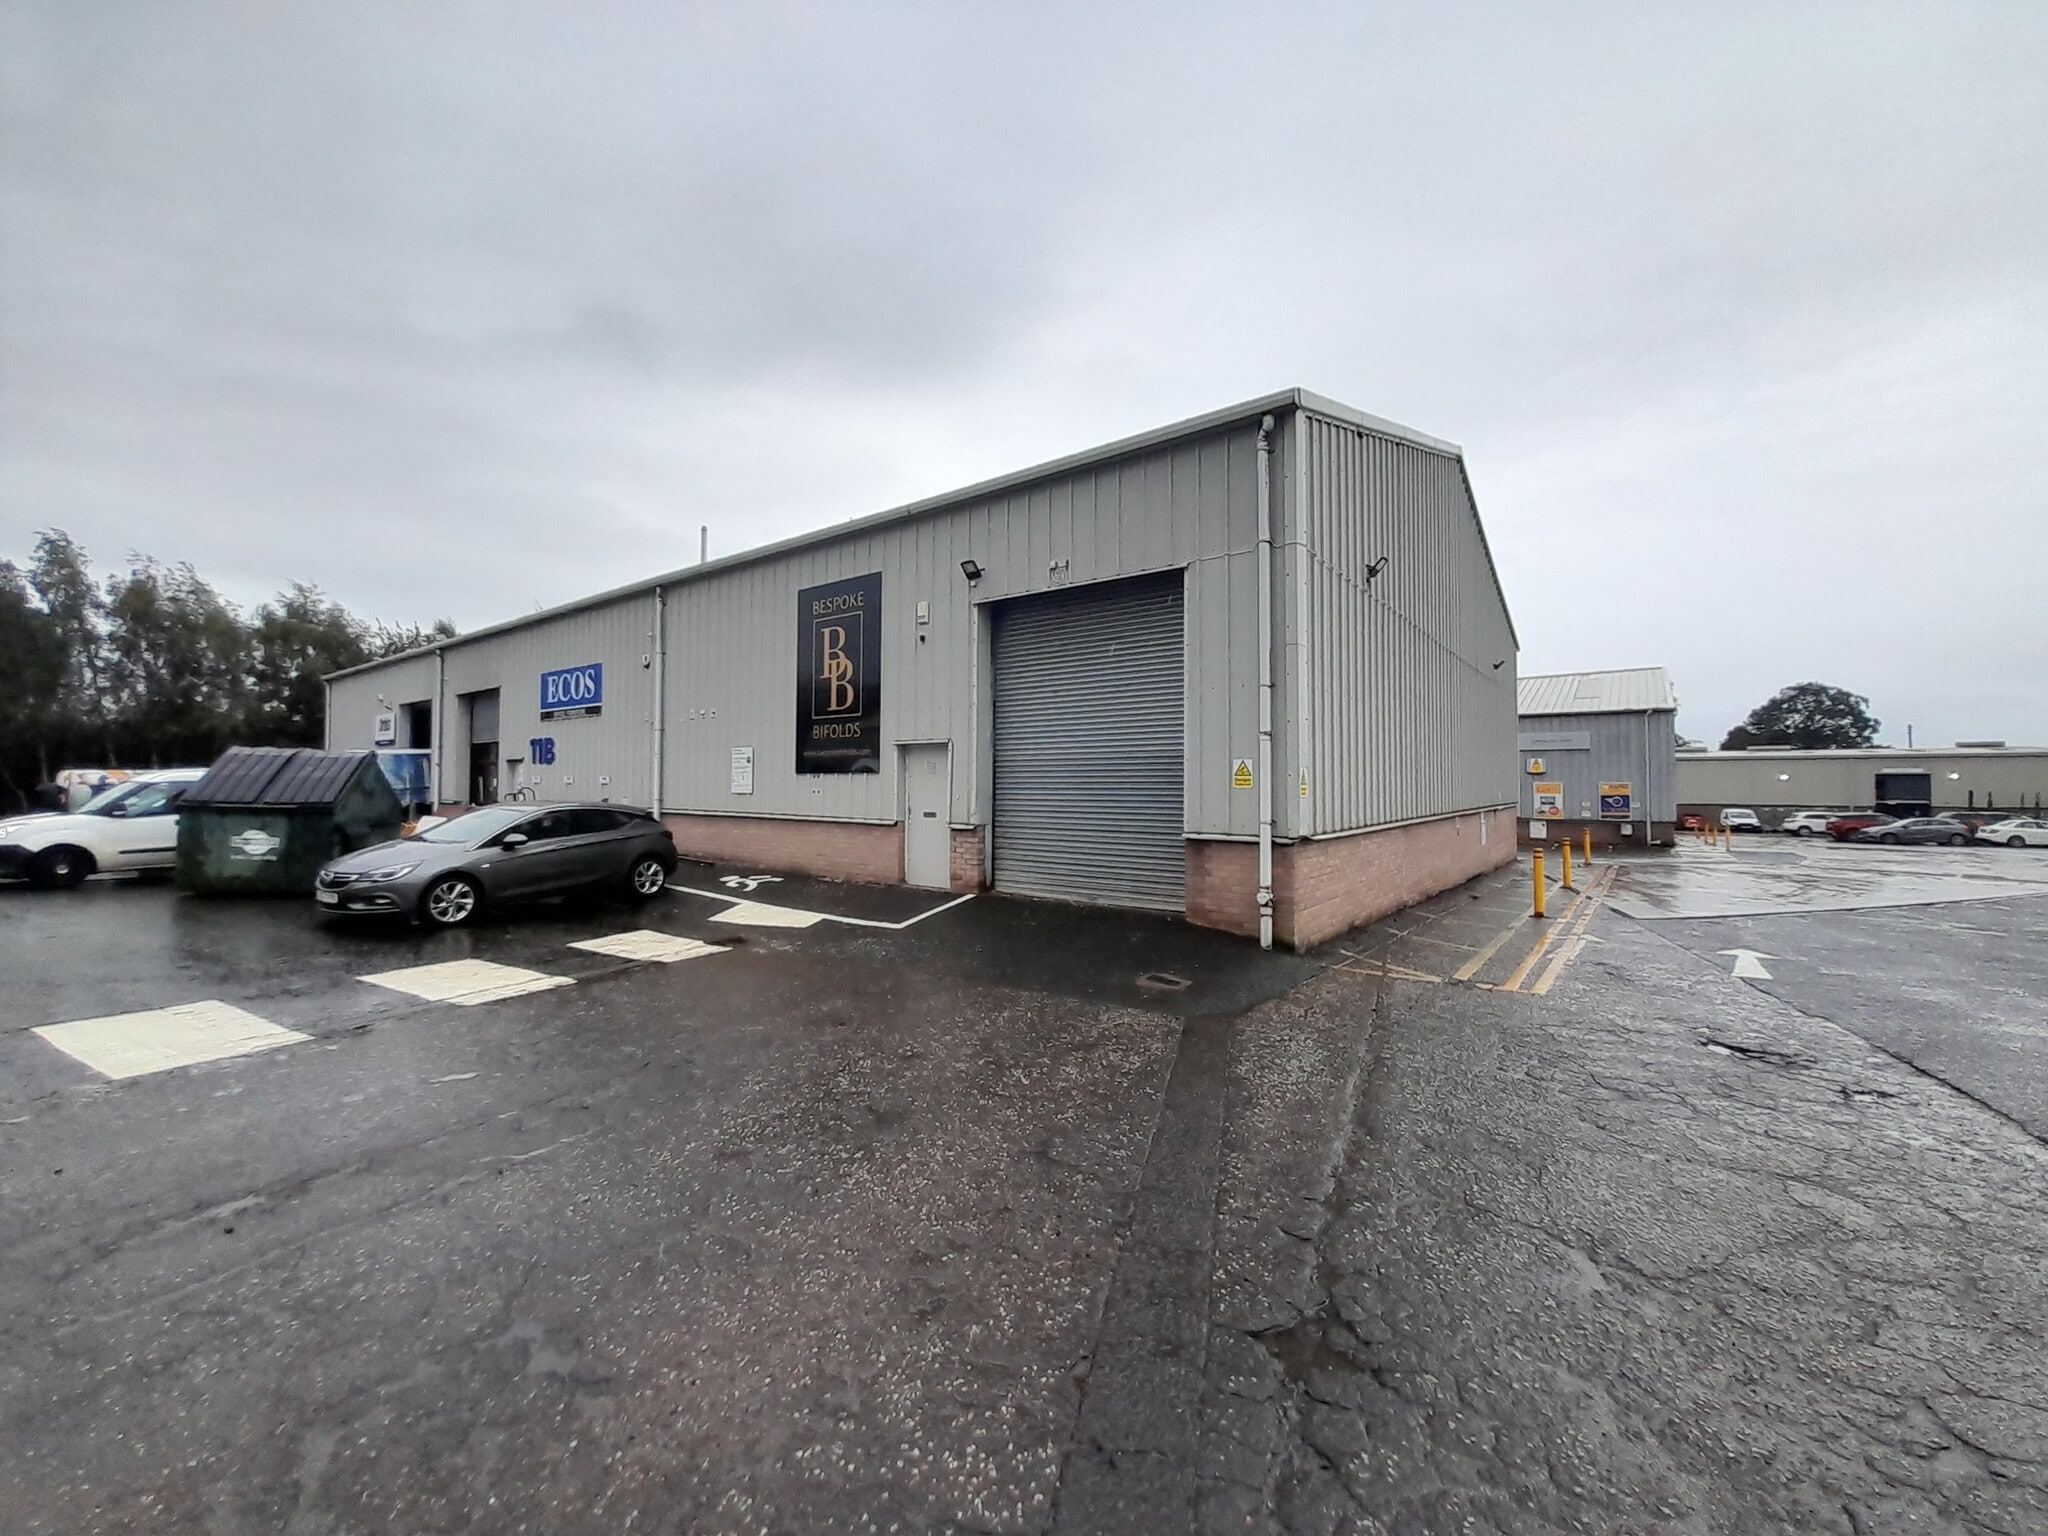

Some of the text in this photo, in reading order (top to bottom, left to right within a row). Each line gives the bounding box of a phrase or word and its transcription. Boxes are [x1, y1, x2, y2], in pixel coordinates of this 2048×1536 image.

[813, 591, 864, 615] BESPOKE
[547, 669, 596, 703] ECOS
[813, 722, 861, 739] BIFOLDS
[530, 737, 555, 765] 11B
